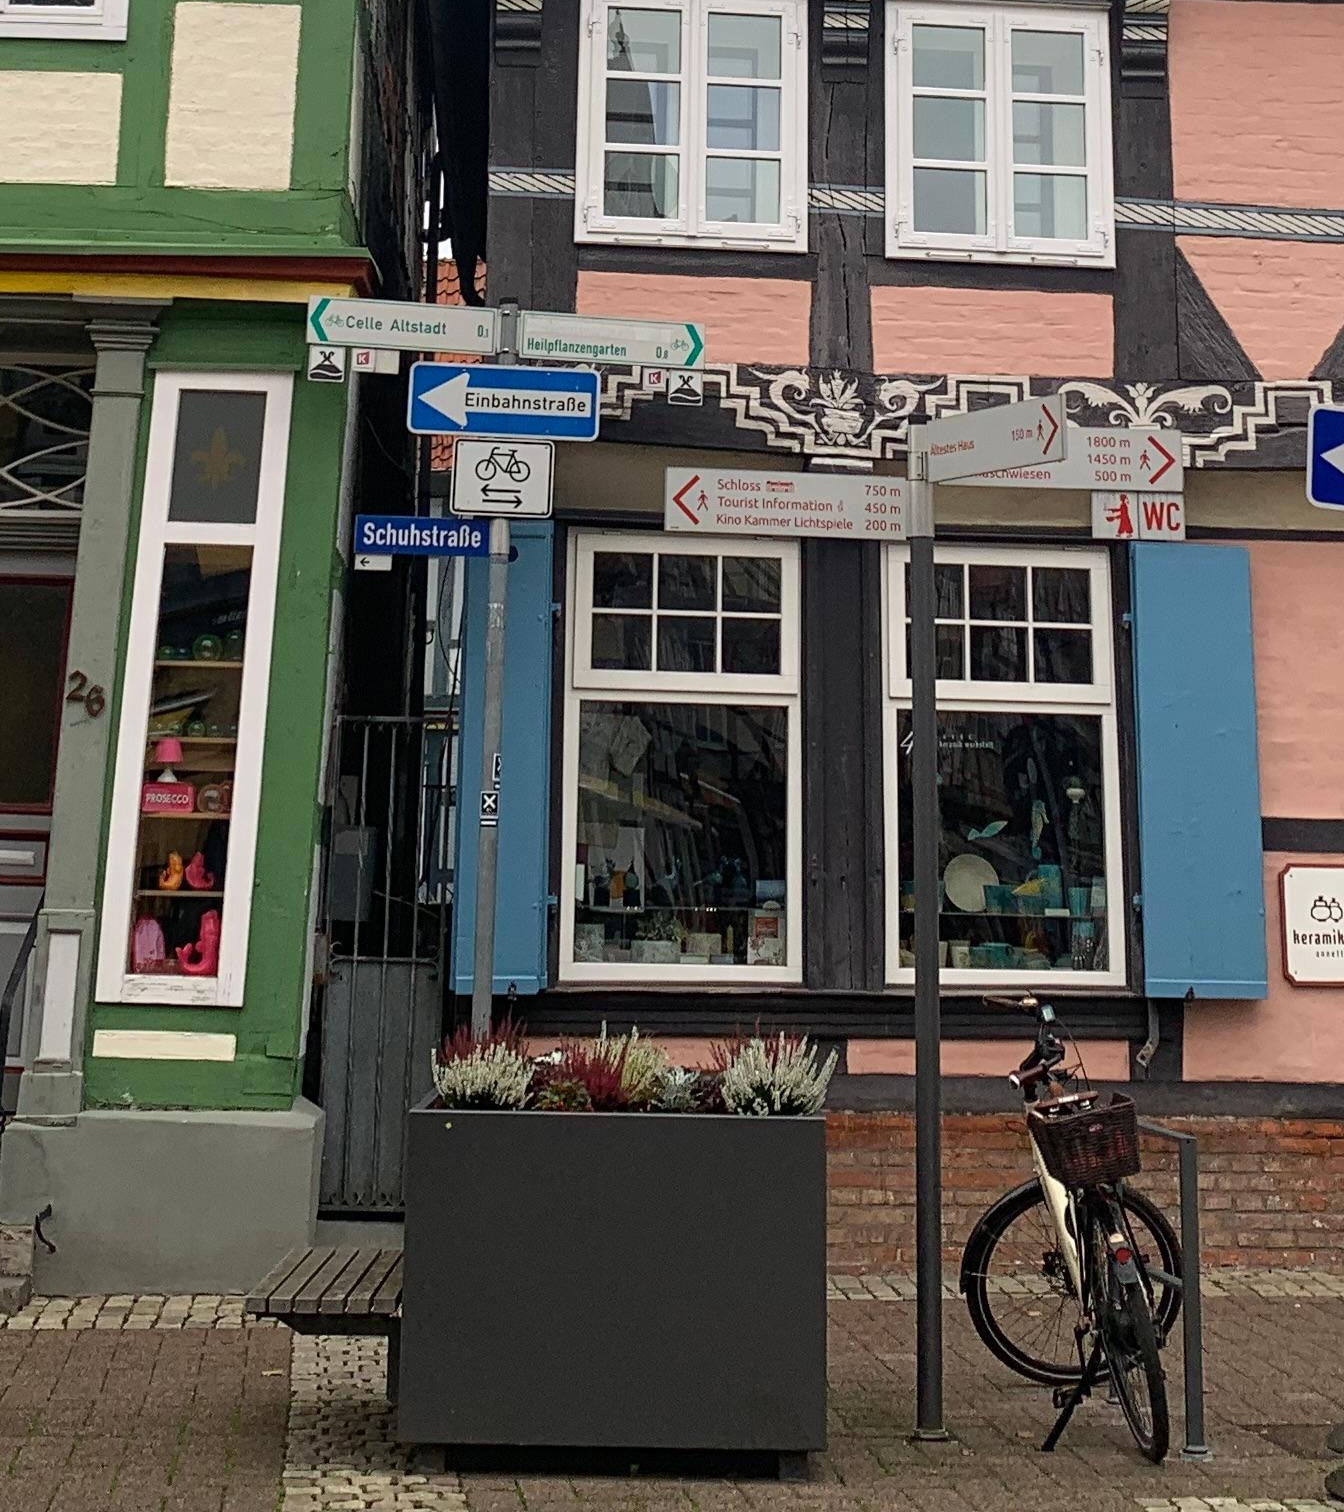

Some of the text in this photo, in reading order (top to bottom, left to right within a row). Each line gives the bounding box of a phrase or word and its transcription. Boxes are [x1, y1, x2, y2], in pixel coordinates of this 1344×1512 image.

[345, 315, 383, 331] Celle
[390, 318, 447, 335] Altstadt
[527, 338, 627, 358] Heilpflanzengarten
[464, 392, 586, 412] Einbahnstraße
[958, 440, 975, 451] Haus
[1011, 429, 1025, 441] 150
[1025, 429, 1033, 439] m
[1087, 436, 1131, 448] 1800 m
[1087, 454, 1131, 465] 1450 m
[1094, 470, 1117, 482] 500
[1120, 473, 1132, 482] m
[717, 478, 901, 497] Schloss 750 m
[718, 496, 901, 514] Tourist Information 450 m
[716, 513, 901, 532] Kino Kammer Lichtspiele 200 m
[1142, 501, 1181, 532] WC
[362, 521, 482, 548] Schuhstraße
[66, 670, 105, 718] 26
[145, 792, 189, 804] PROSECCO
